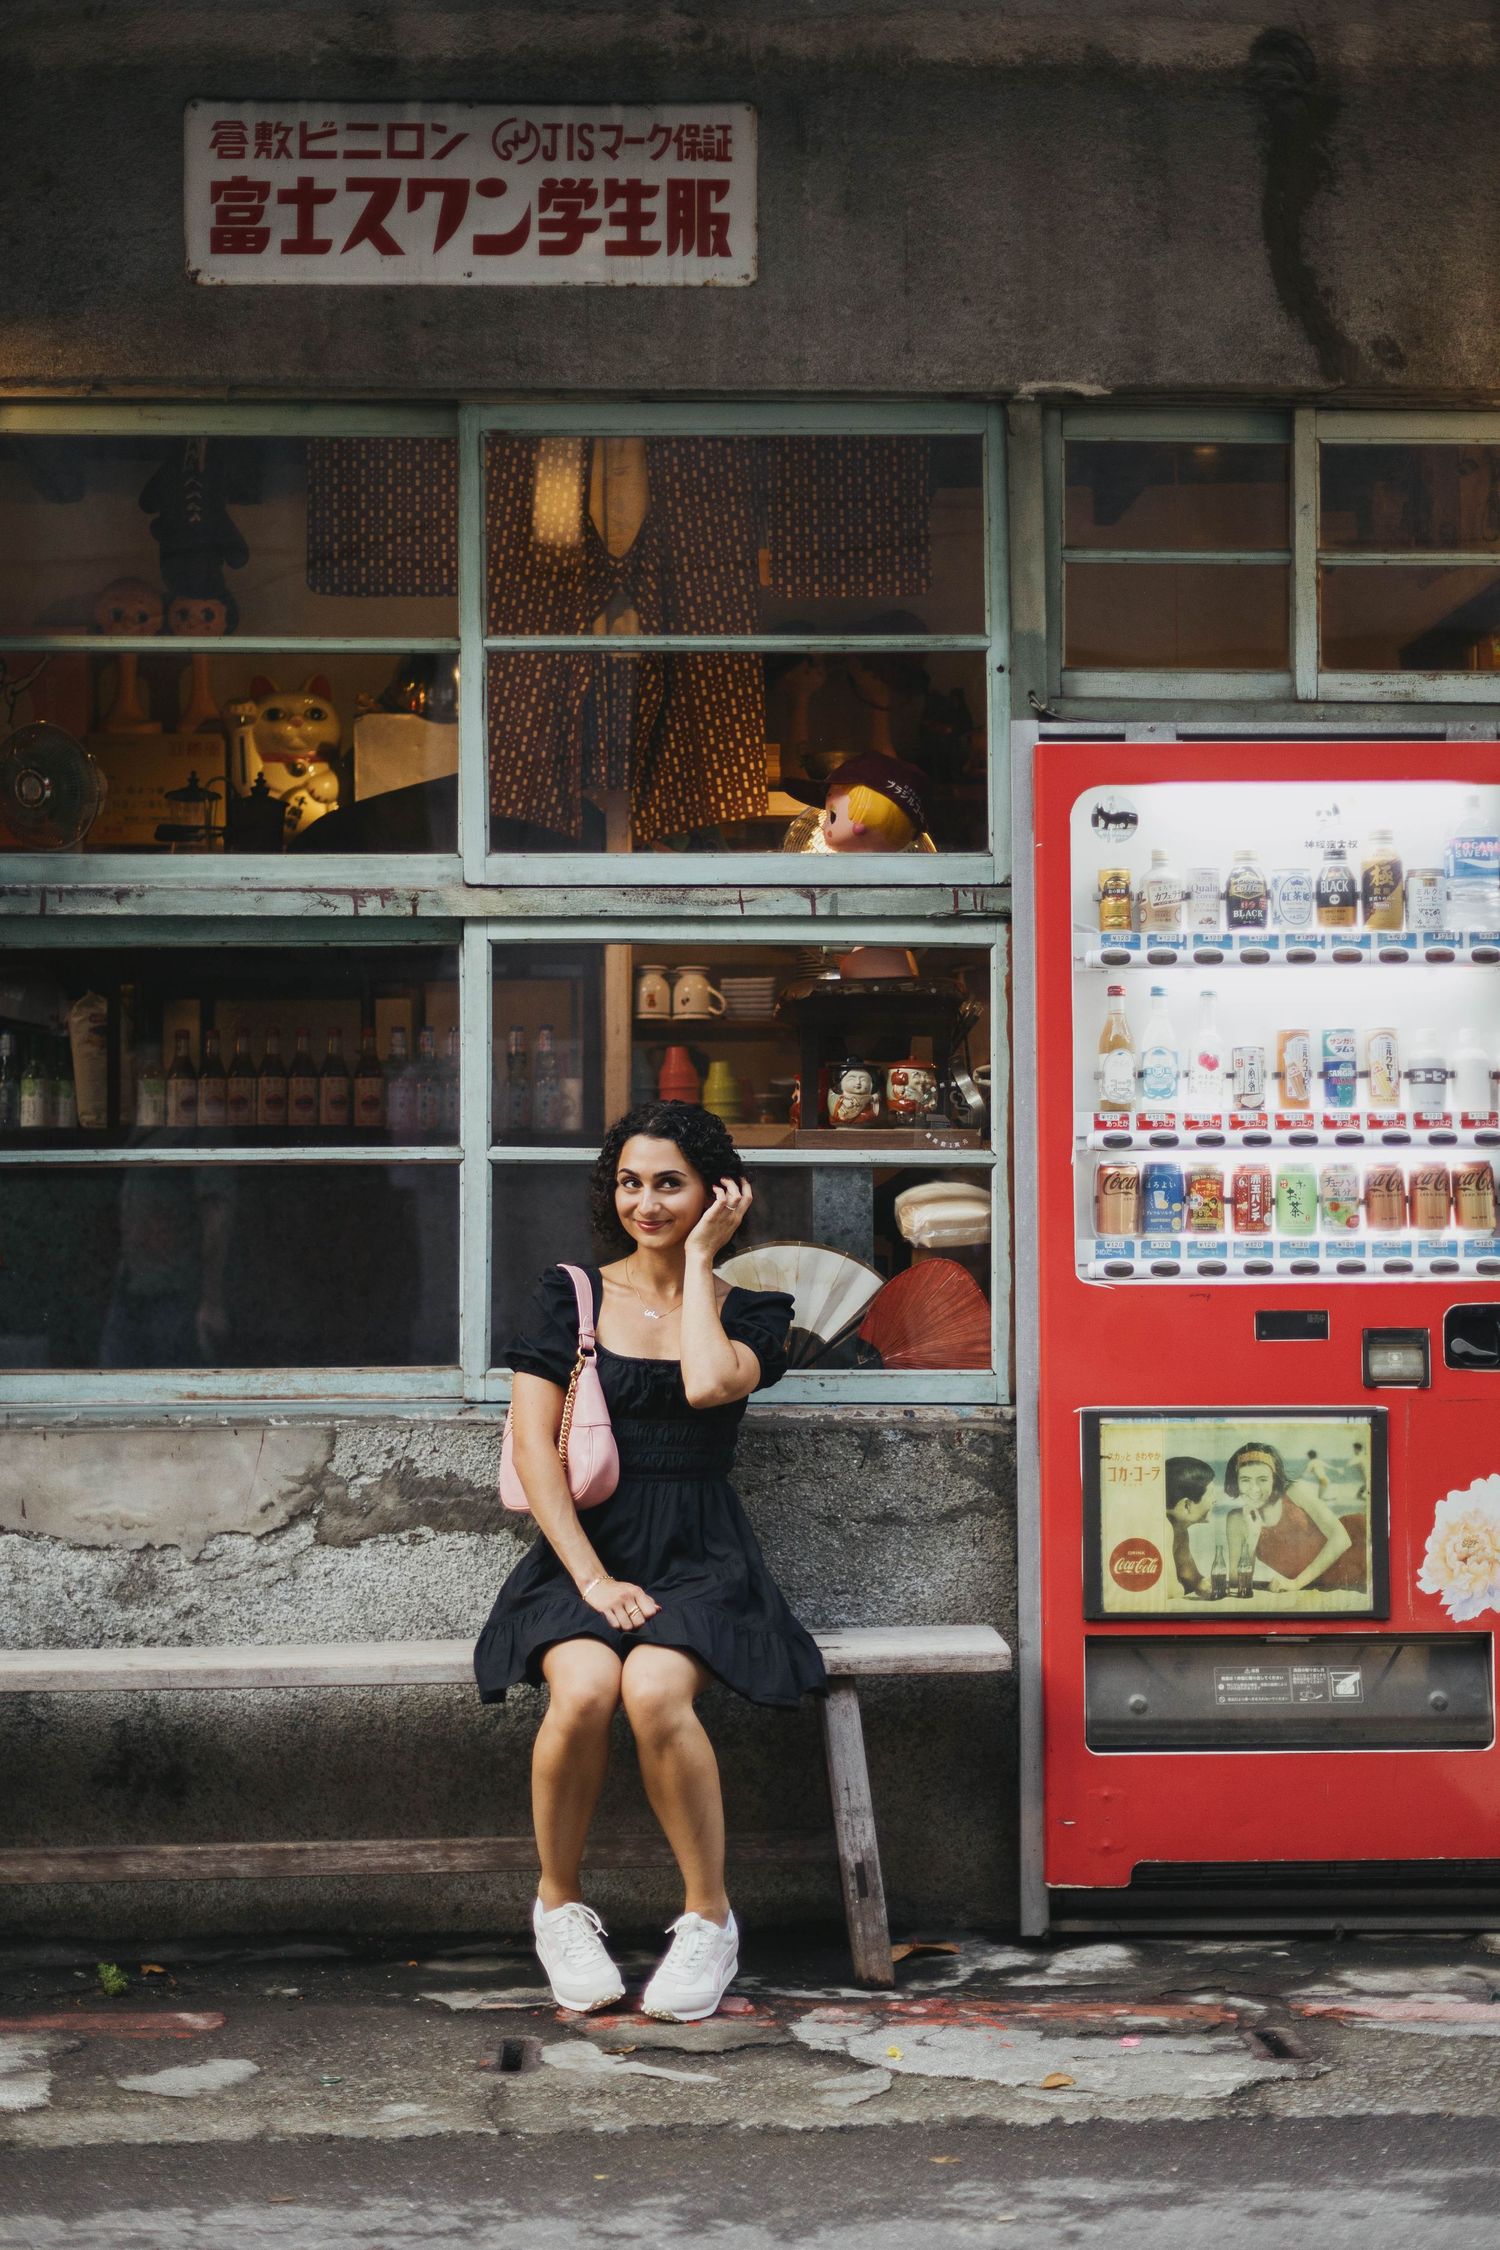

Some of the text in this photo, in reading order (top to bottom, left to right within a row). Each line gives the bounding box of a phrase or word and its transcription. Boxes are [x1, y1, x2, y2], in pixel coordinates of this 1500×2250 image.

[209, 119, 734, 163] 倉敷ビニロン JISマーク保証
[209, 175, 733, 258] 富士スワン学生服
[1320, 879, 1349, 893] BLACK
[1233, 909, 1264, 918] BLACK
[1325, 1176, 1357, 1187] チューハイ
[1250, 1173, 1261, 1222] 赤玉パンチ
[1135, 1452, 1161, 1461] さわやか
[1107, 1466, 1161, 1482] コカ・コーラ
[1113, 1557, 1160, 1574] Coca-Cola
